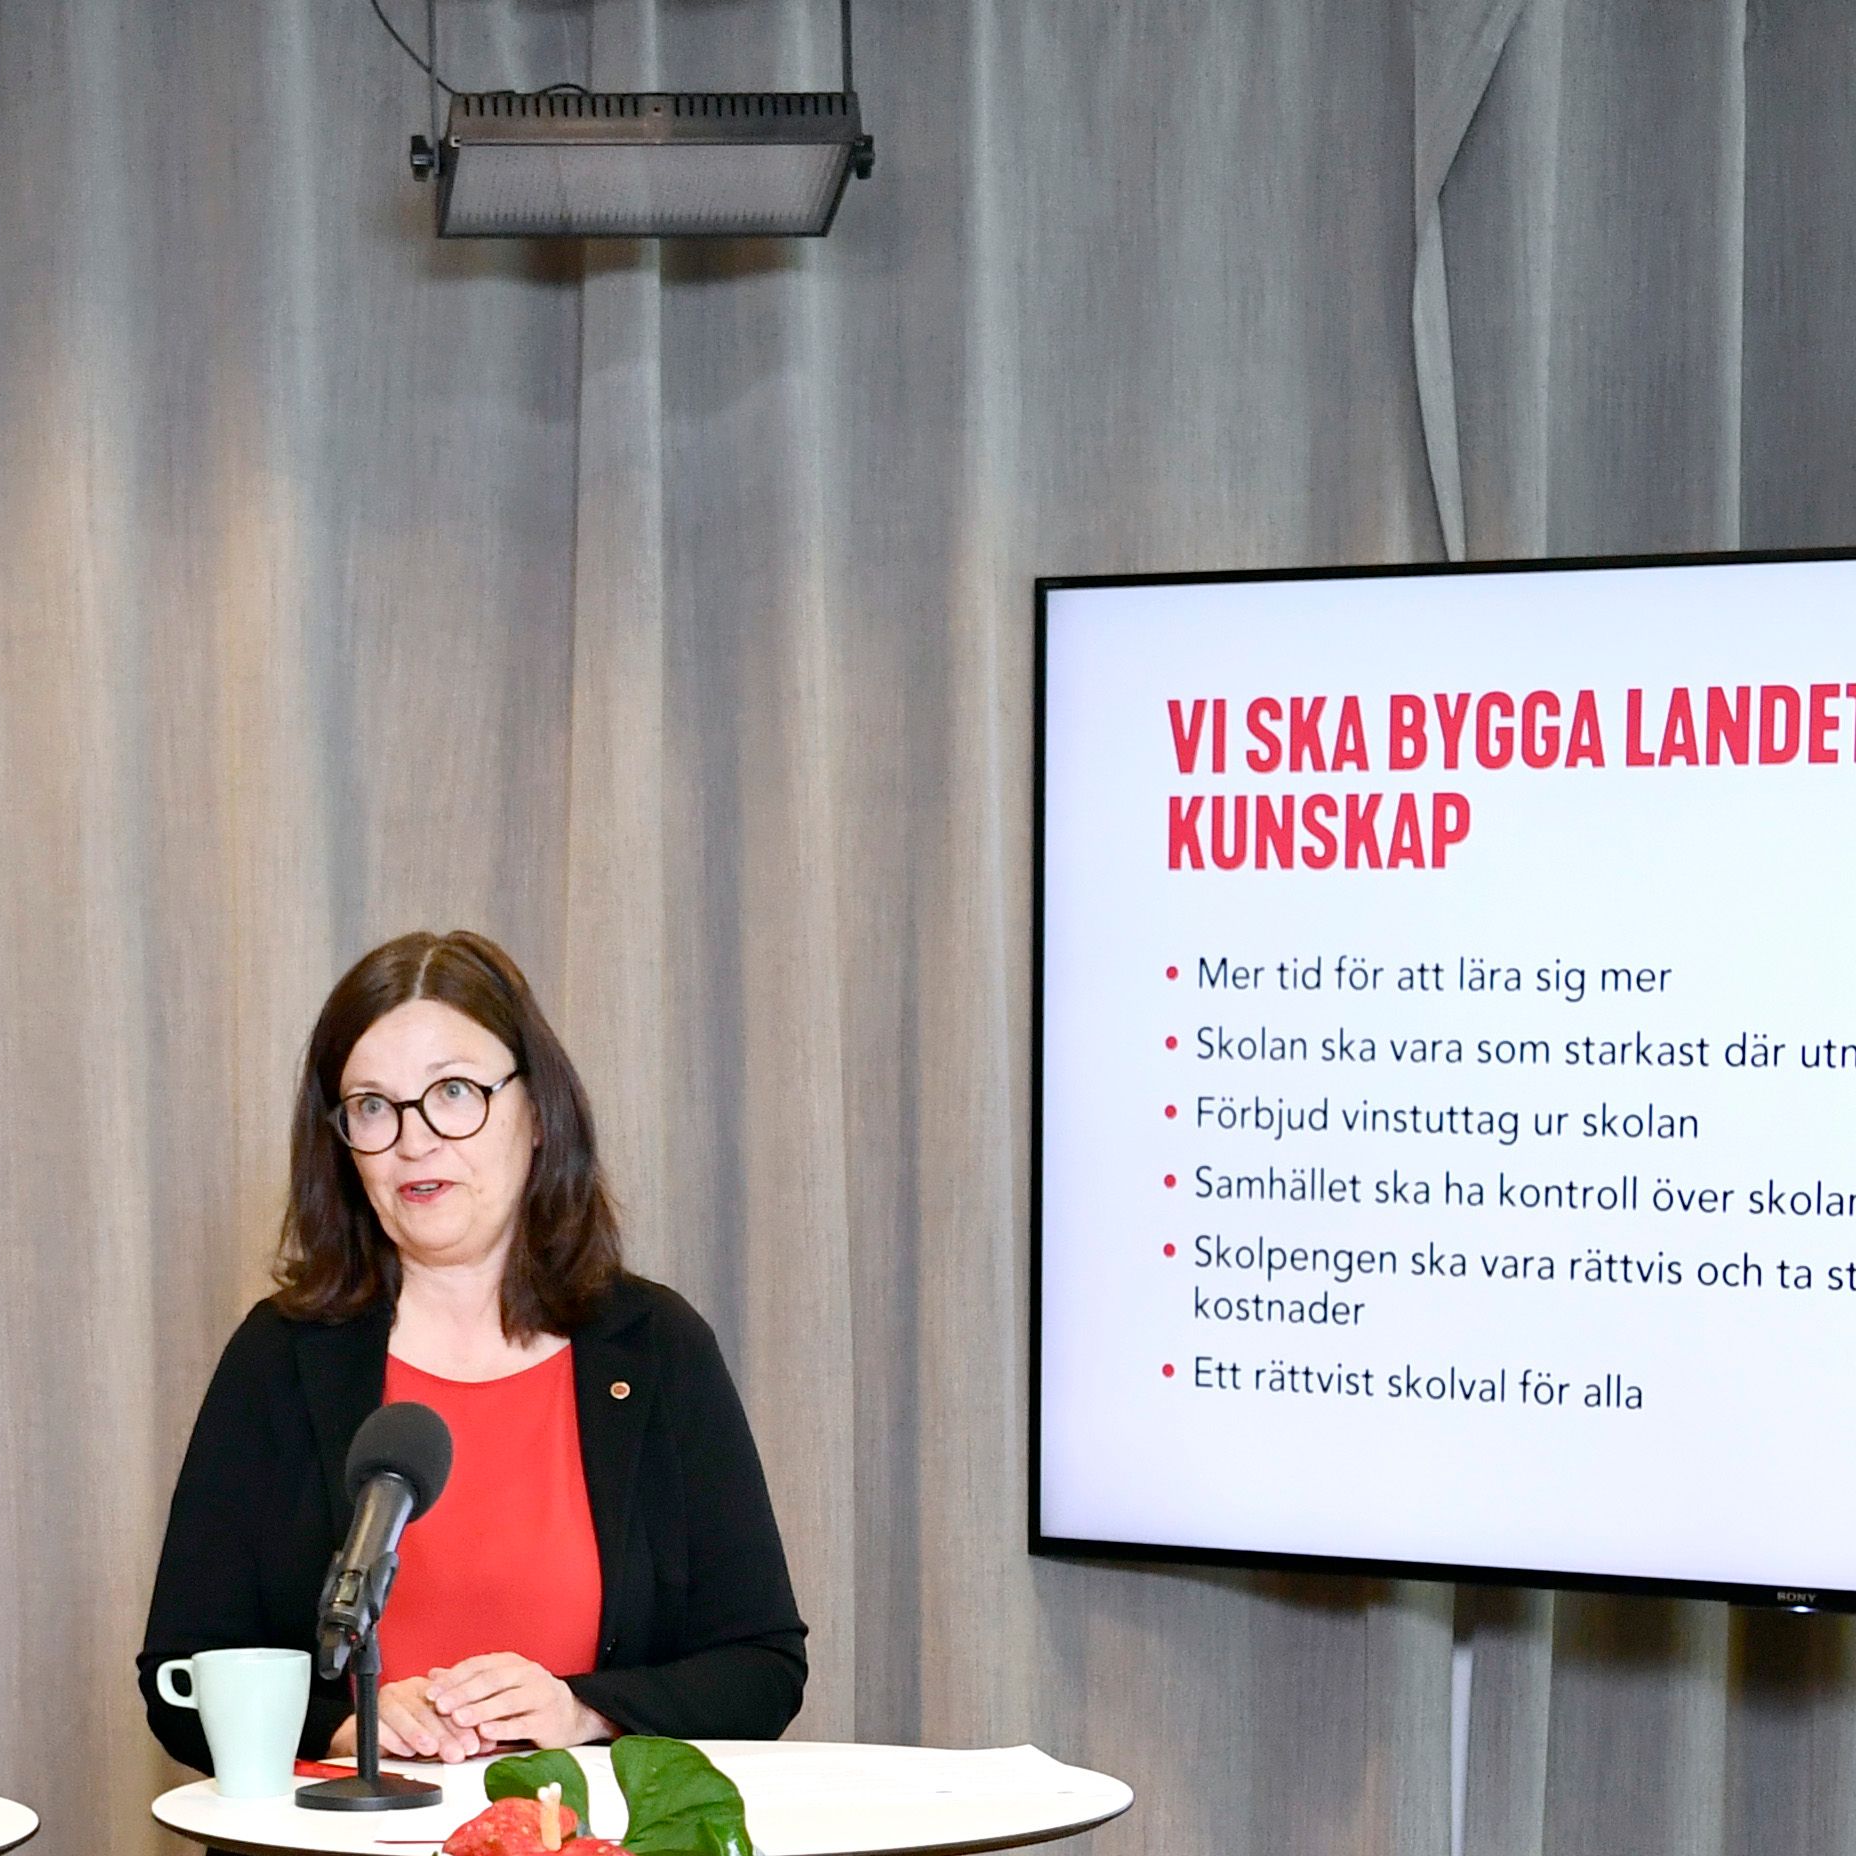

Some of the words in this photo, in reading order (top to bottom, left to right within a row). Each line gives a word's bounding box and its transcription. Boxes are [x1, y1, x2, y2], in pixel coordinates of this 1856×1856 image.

[1167, 698, 1226, 774] VI
[1246, 695, 1369, 774] SKA
[1389, 690, 1605, 771] BYGGA
[1168, 792, 1470, 871] KUNSKAP
[1199, 957, 1264, 989] Mer
[1277, 956, 1321, 990] tid
[1335, 955, 1384, 990] för
[1398, 963, 1444, 991] att
[1460, 956, 1521, 991] lära
[1537, 959, 1585, 1002] sig
[1602, 969, 1672, 992] mer
[1197, 1026, 1307, 1061] Skolan
[1322, 1027, 1375, 1062] ska
[1390, 1039, 1462, 1063] vara
[1478, 1040, 1549, 1064] som
[1565, 1031, 1709, 1067] starkast
[1725, 1032, 1786, 1067] där
[1198, 1096, 1328, 1140] Förbjud
[1342, 1100, 1518, 1145] vinstuttag
[1535, 1113, 1568, 1136] ur
[1583, 1102, 1697, 1138] skolan
[1196, 1165, 1361, 1203] Samhället
[1375, 1169, 1429, 1204] ska
[1446, 1171, 1483, 1206] ha
[1500, 1172, 1637, 1210] kontroll
[1653, 1178, 1734, 1213] över
[1195, 1234, 1396, 1283] Skolpengen
[1411, 1242, 1466, 1277] ska
[1481, 1255, 1554, 1280] vara
[1570, 1249, 1682, 1285] rättvis
[1698, 1252, 1761, 1287] och
[1777, 1260, 1811, 1289] ta
[1195, 1286, 1365, 1325] kostnader
[1195, 1356, 1241, 1390] Ett
[1256, 1360, 1374, 1396] rättvist
[1388, 1364, 1505, 1402] skolval
[1519, 1369, 1570, 1405] för
[1584, 1374, 1642, 1409] alla
[1777, 1591, 1817, 1603] SONY
